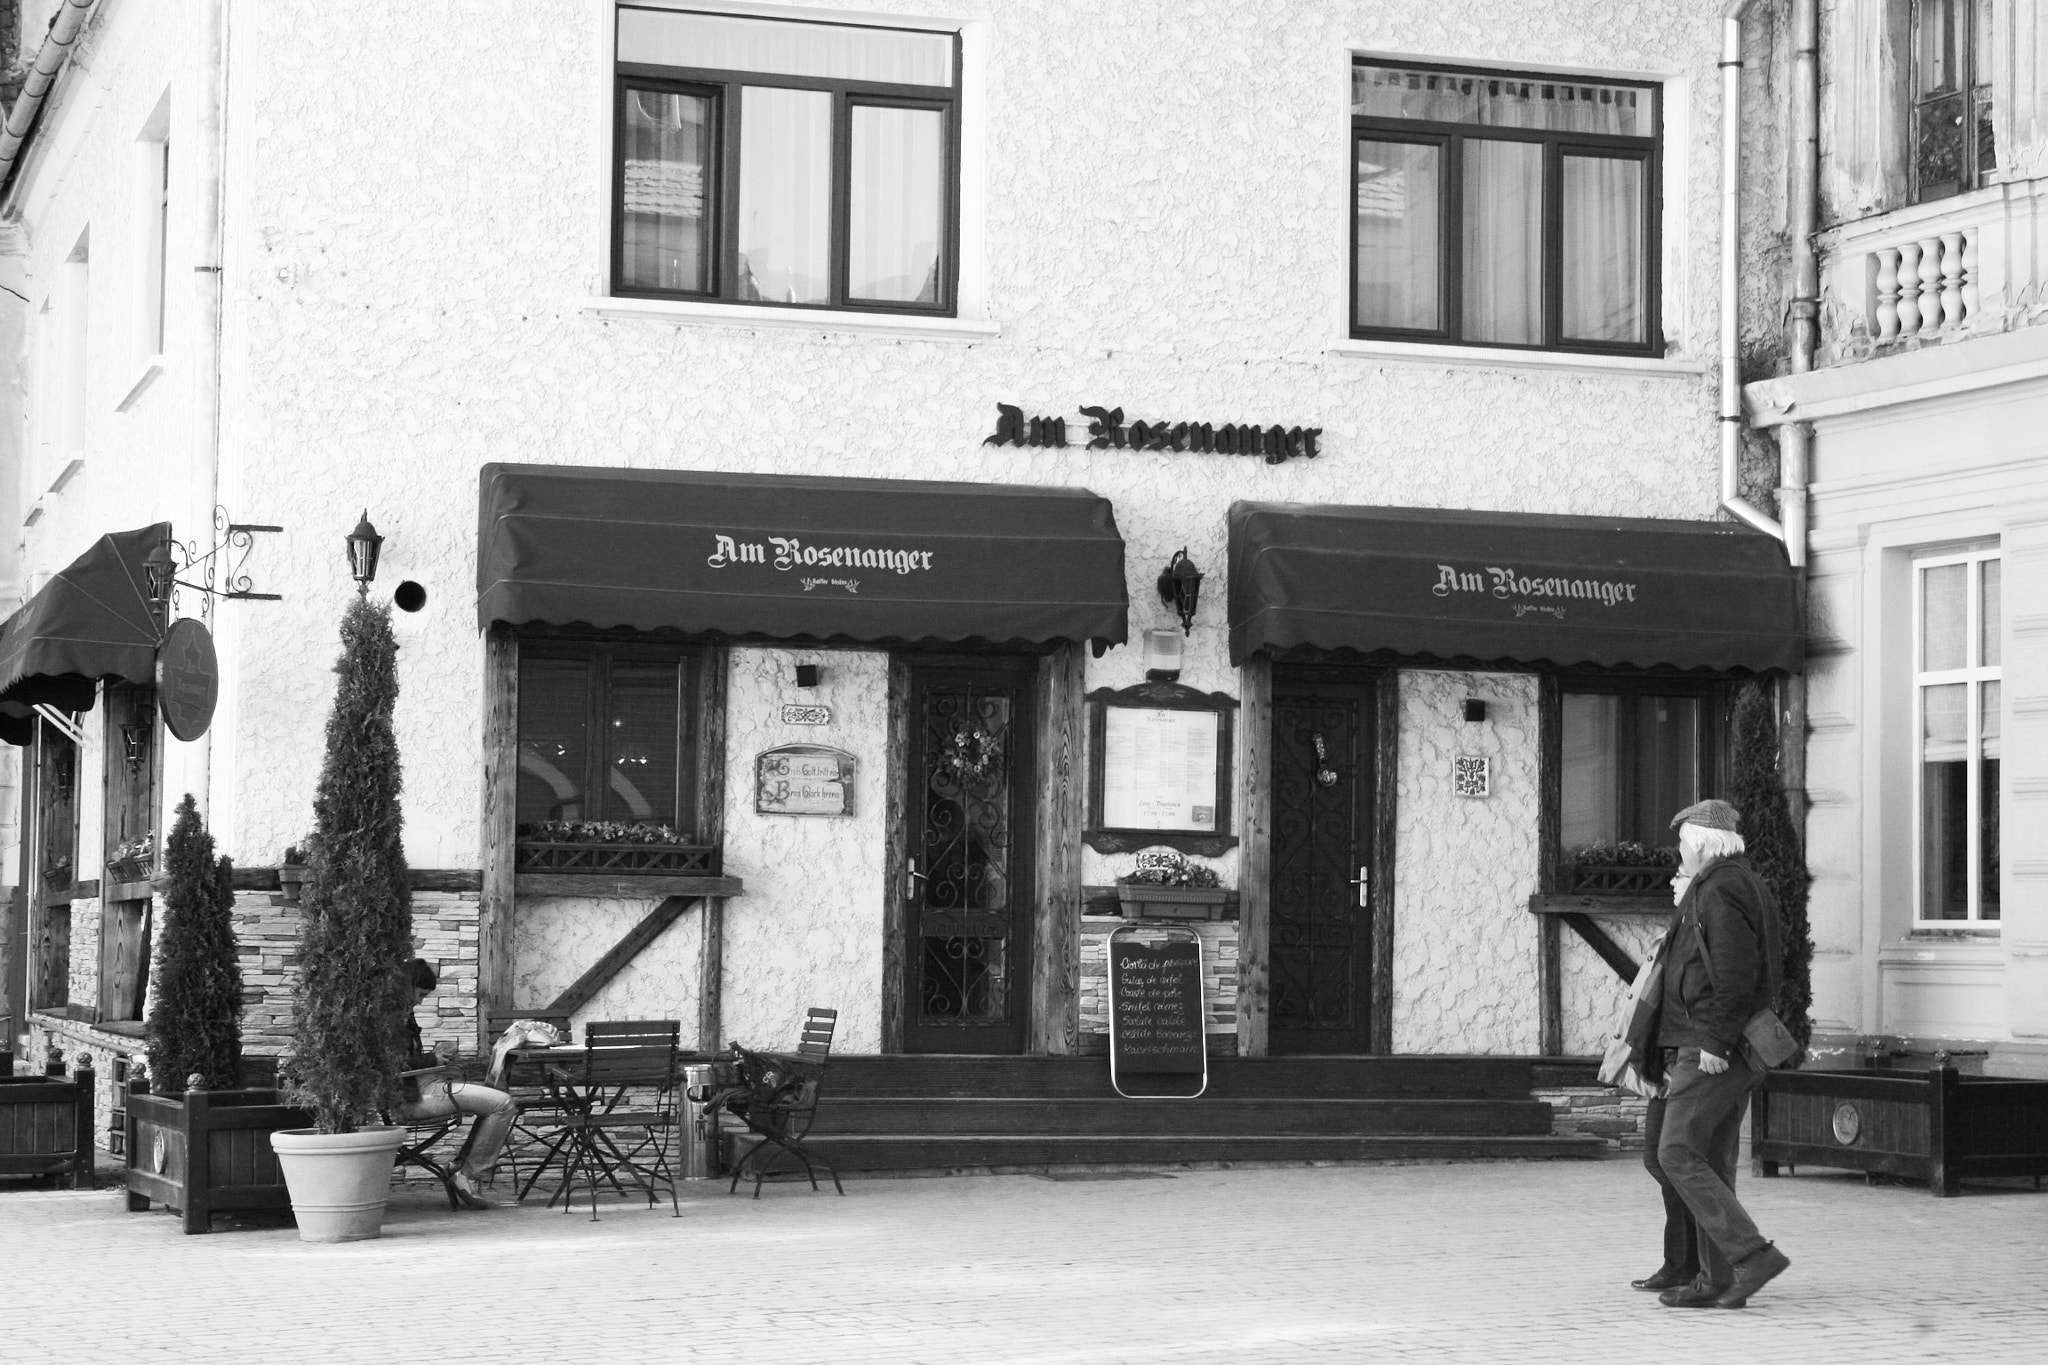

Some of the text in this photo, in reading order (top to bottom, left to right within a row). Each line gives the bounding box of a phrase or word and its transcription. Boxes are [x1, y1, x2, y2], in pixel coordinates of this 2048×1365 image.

[983, 401, 1323, 465] Am Rosenanger
[707, 533, 934, 575] Am Rosenanger
[1432, 563, 1637, 606] Am Rosenanger
[1148, 958, 1160, 970] de
[1146, 975, 1157, 985] de
[1148, 988, 1160, 998] de
